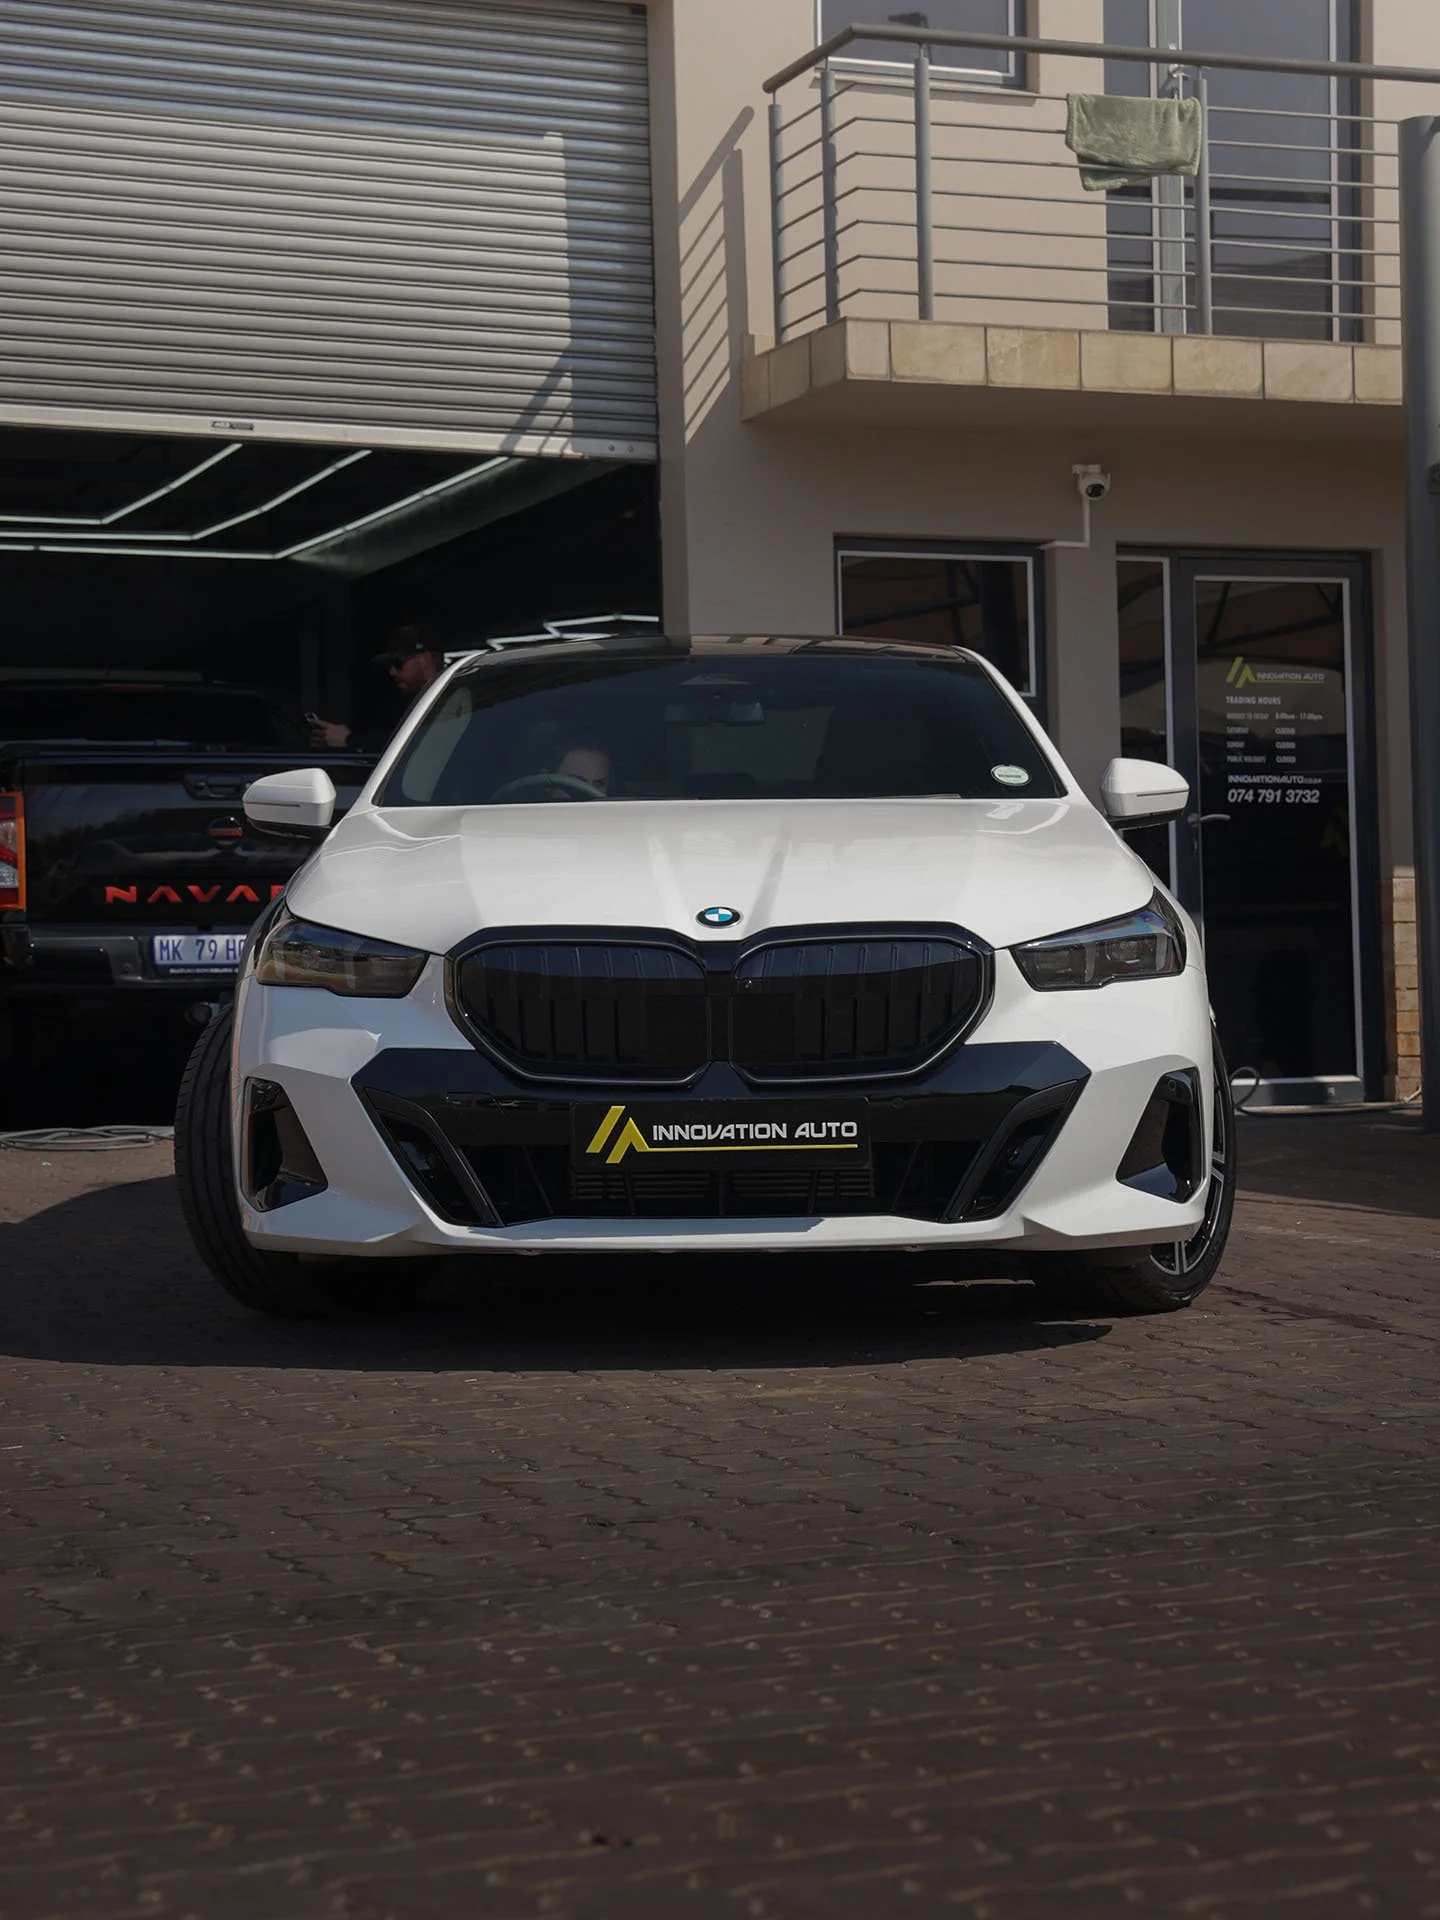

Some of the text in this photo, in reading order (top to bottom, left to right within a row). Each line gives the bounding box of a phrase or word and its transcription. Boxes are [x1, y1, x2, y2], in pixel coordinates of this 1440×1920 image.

[1226, 696, 1281, 705] TRADING HOURS
[1228, 788, 1320, 803] 074 791 3732
[159, 939, 183, 961] MK
[195, 939, 218, 961] 79
[652, 1121, 858, 1141] INNOVATION AUTO
